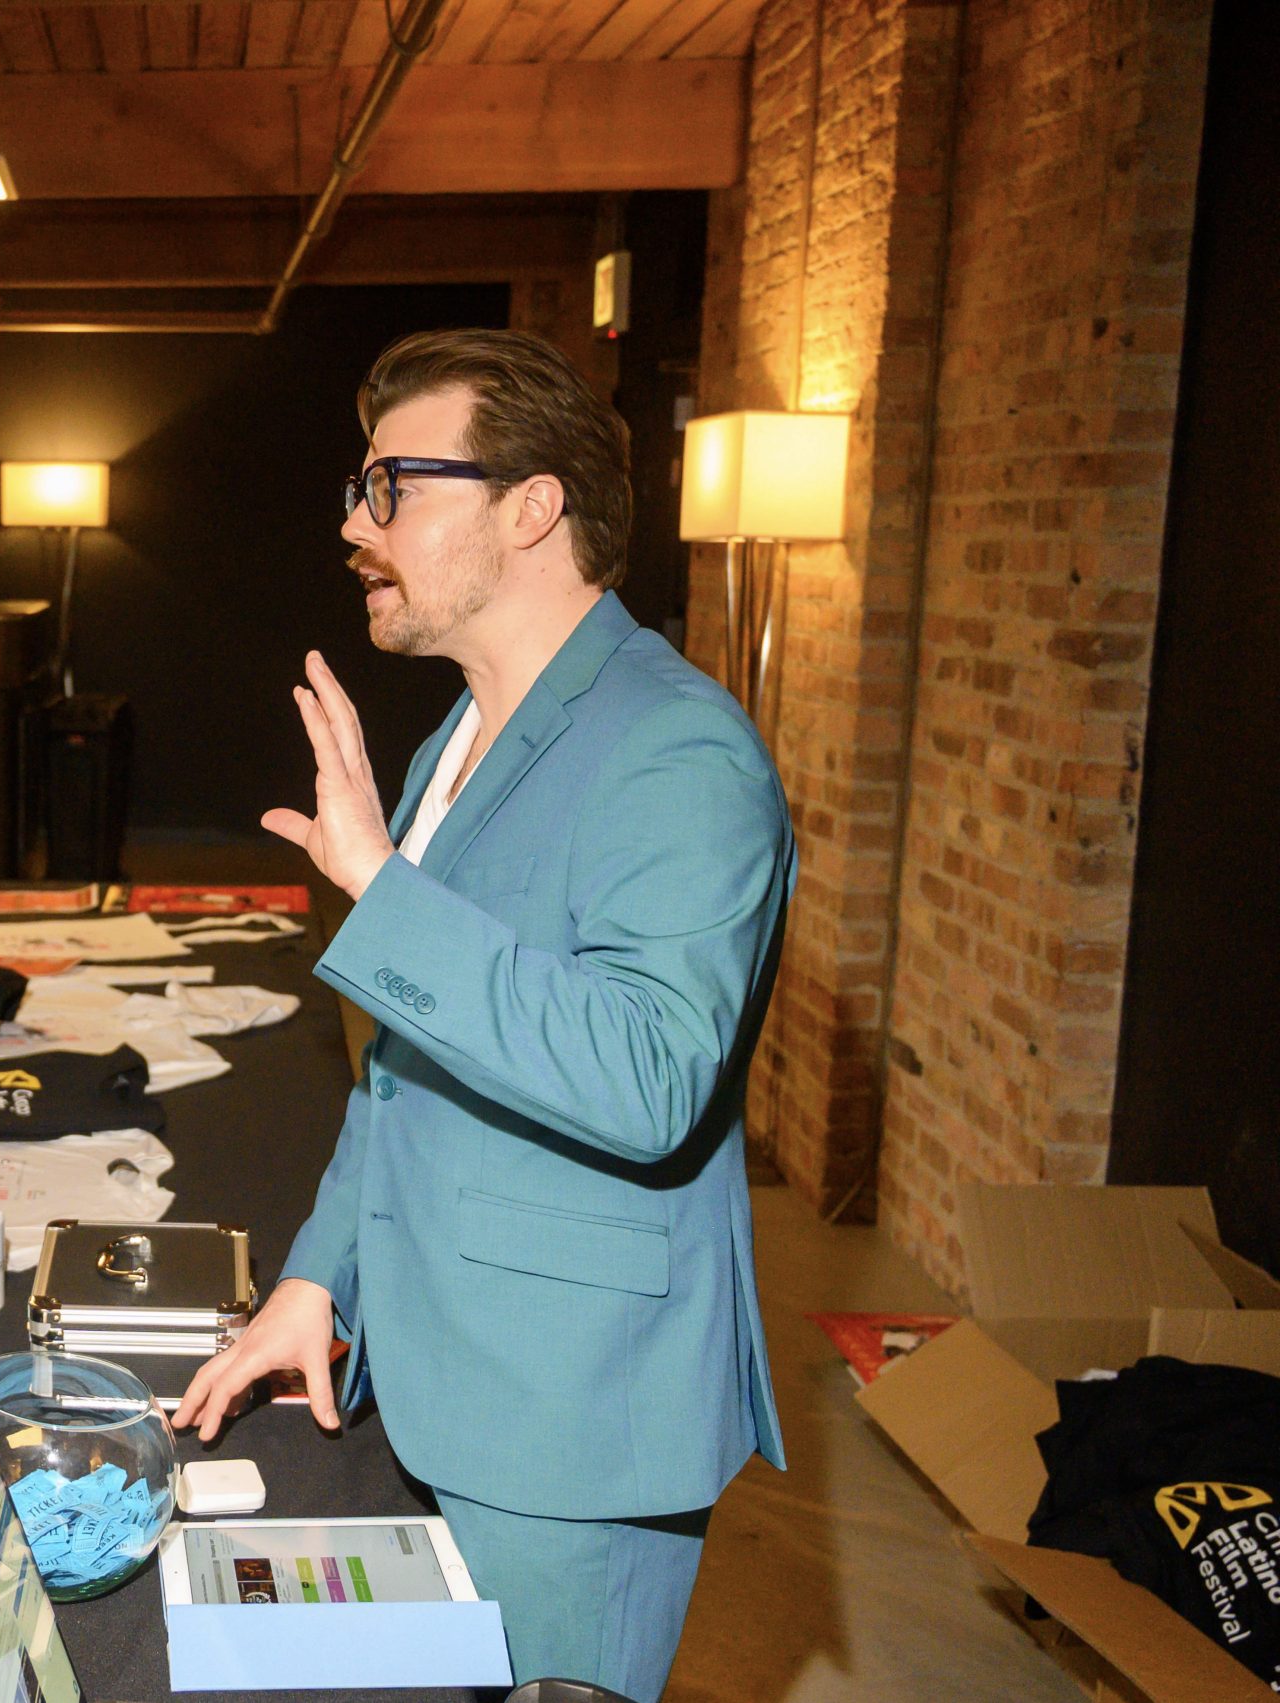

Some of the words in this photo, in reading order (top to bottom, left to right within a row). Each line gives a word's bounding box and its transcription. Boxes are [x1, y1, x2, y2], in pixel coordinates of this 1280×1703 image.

[1190, 1540, 1252, 1644] Festival
[1206, 1528, 1249, 1590] Film
[1228, 1520, 1280, 1605] Latino
